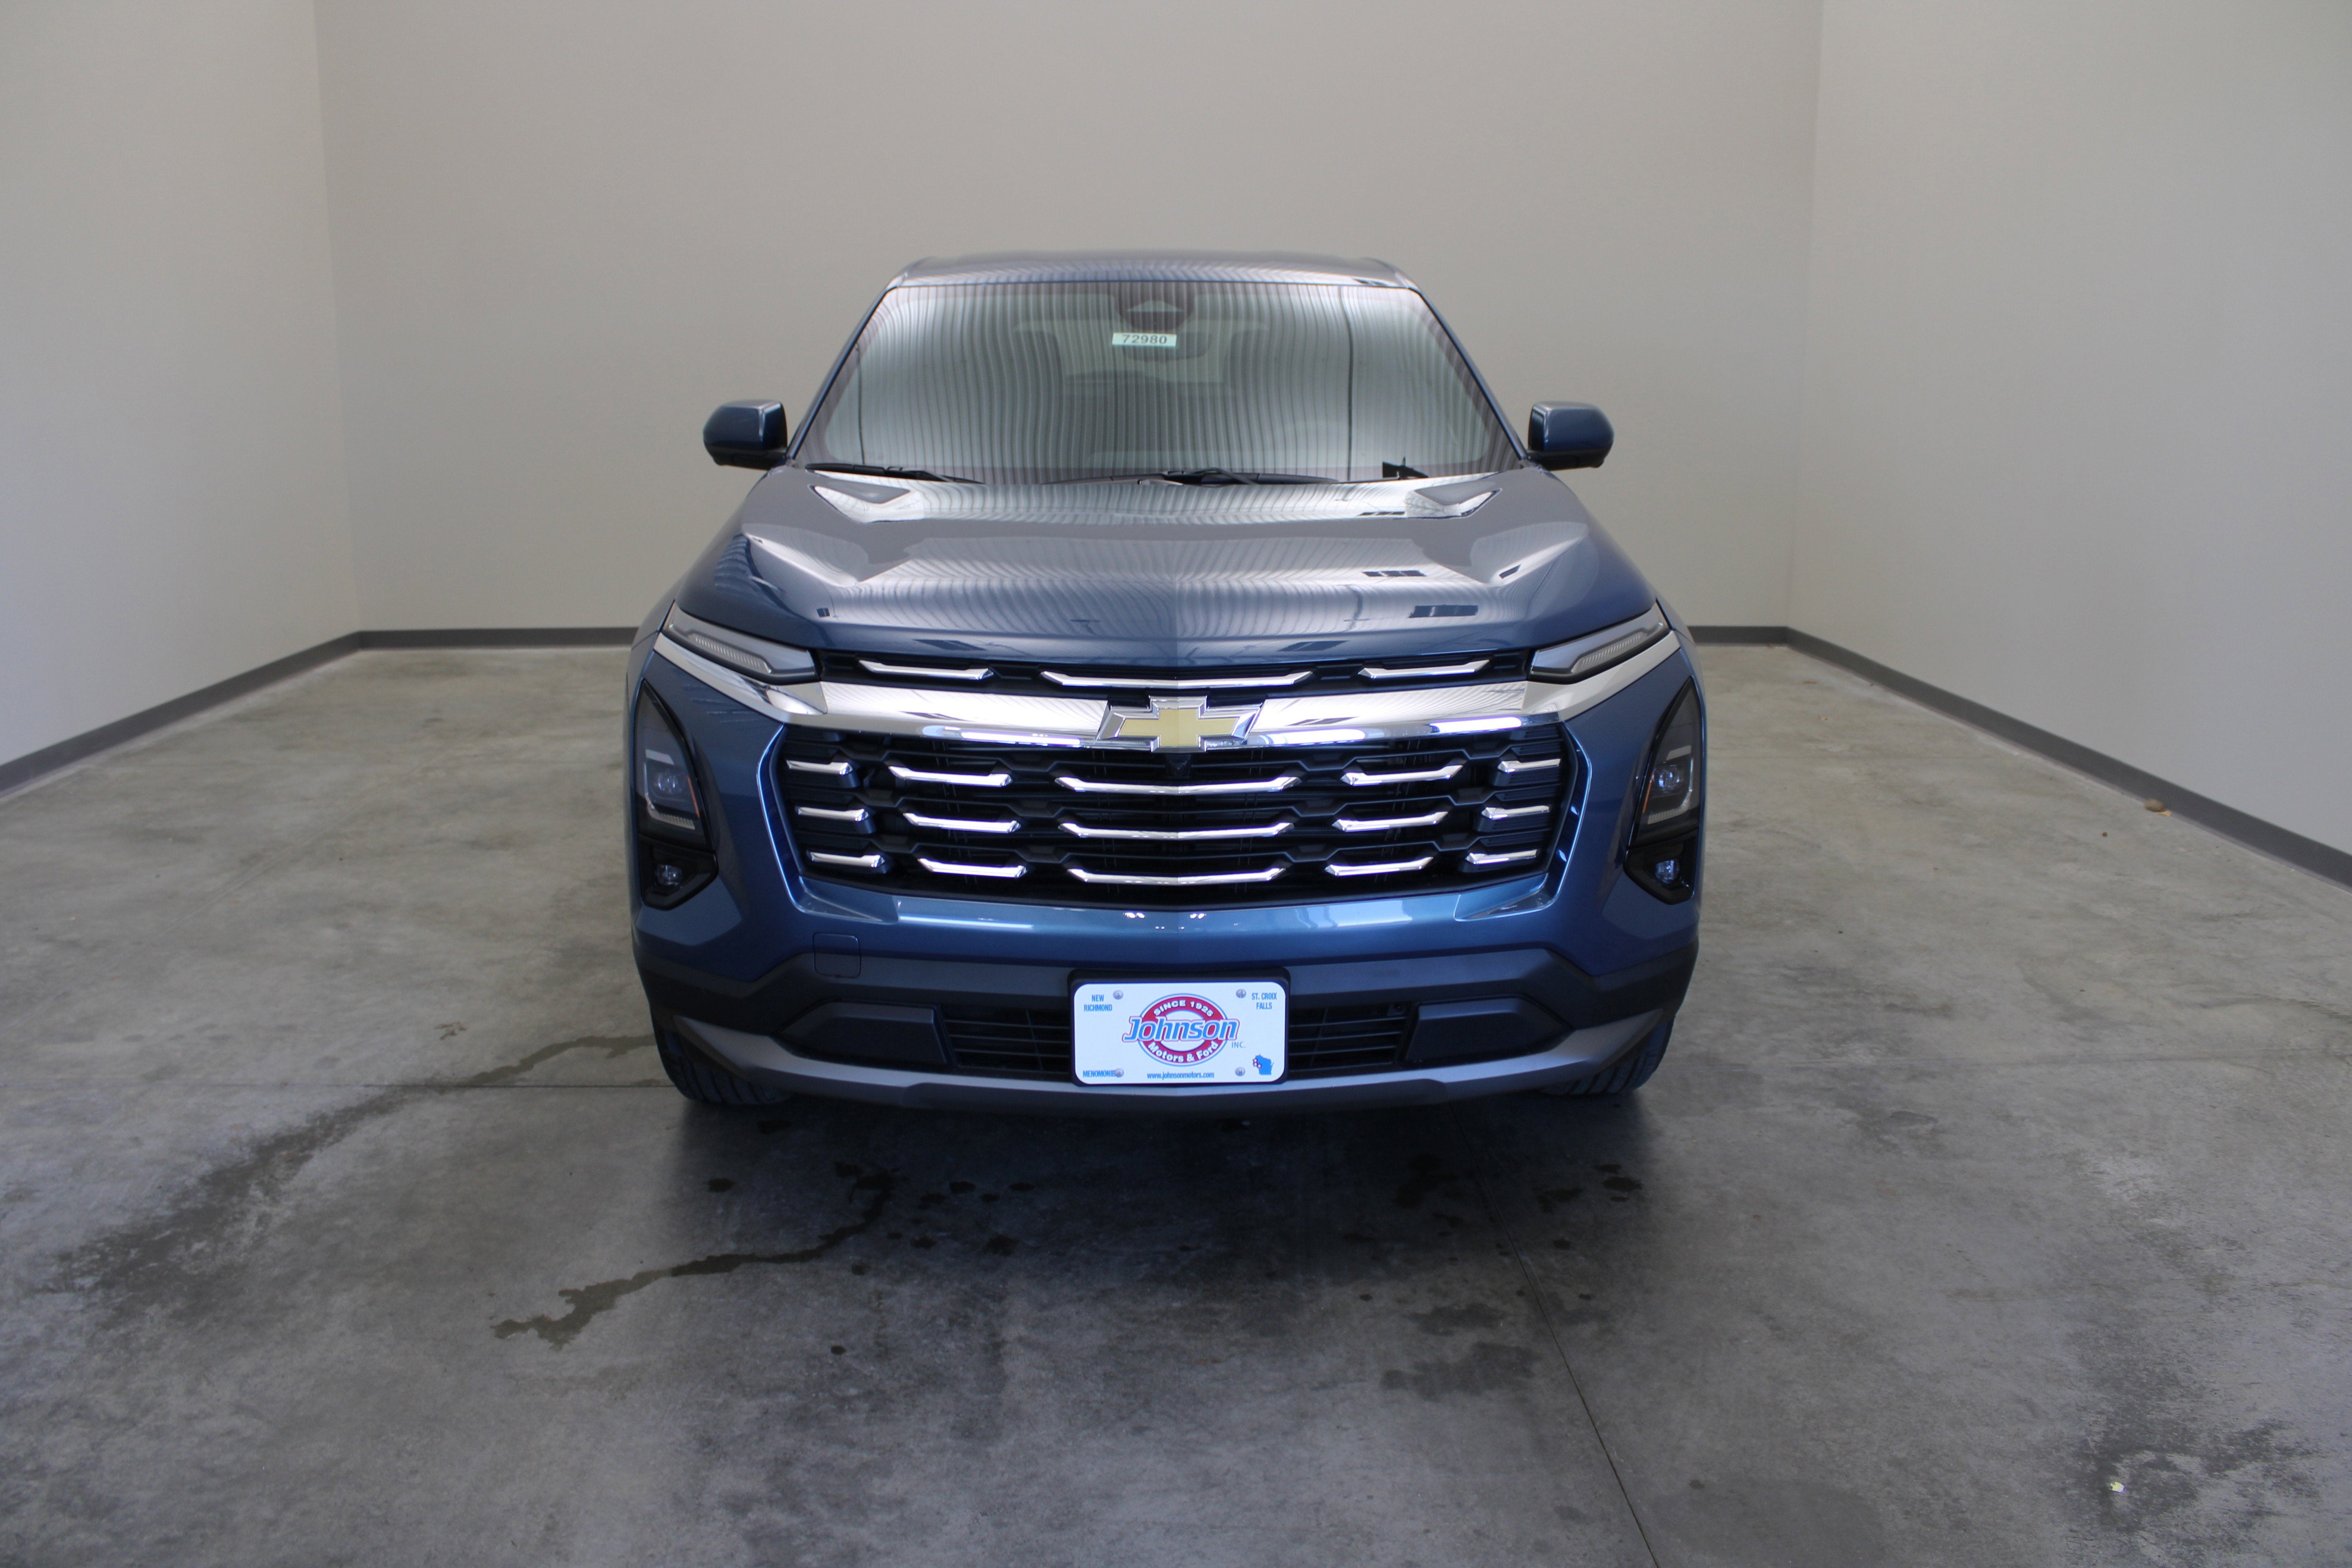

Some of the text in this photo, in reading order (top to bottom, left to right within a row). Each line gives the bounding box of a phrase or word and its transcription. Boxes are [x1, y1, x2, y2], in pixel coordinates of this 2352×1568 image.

[1123, 334, 1167, 344] 72980
[1154, 1000, 1213, 1017] SINCE 1925
[1123, 1017, 1239, 1042] Johnson
[1148, 1041, 1218, 1062] Motors & Ford
[1147, 1071, 1214, 1080] www.johnsonmotors.com
